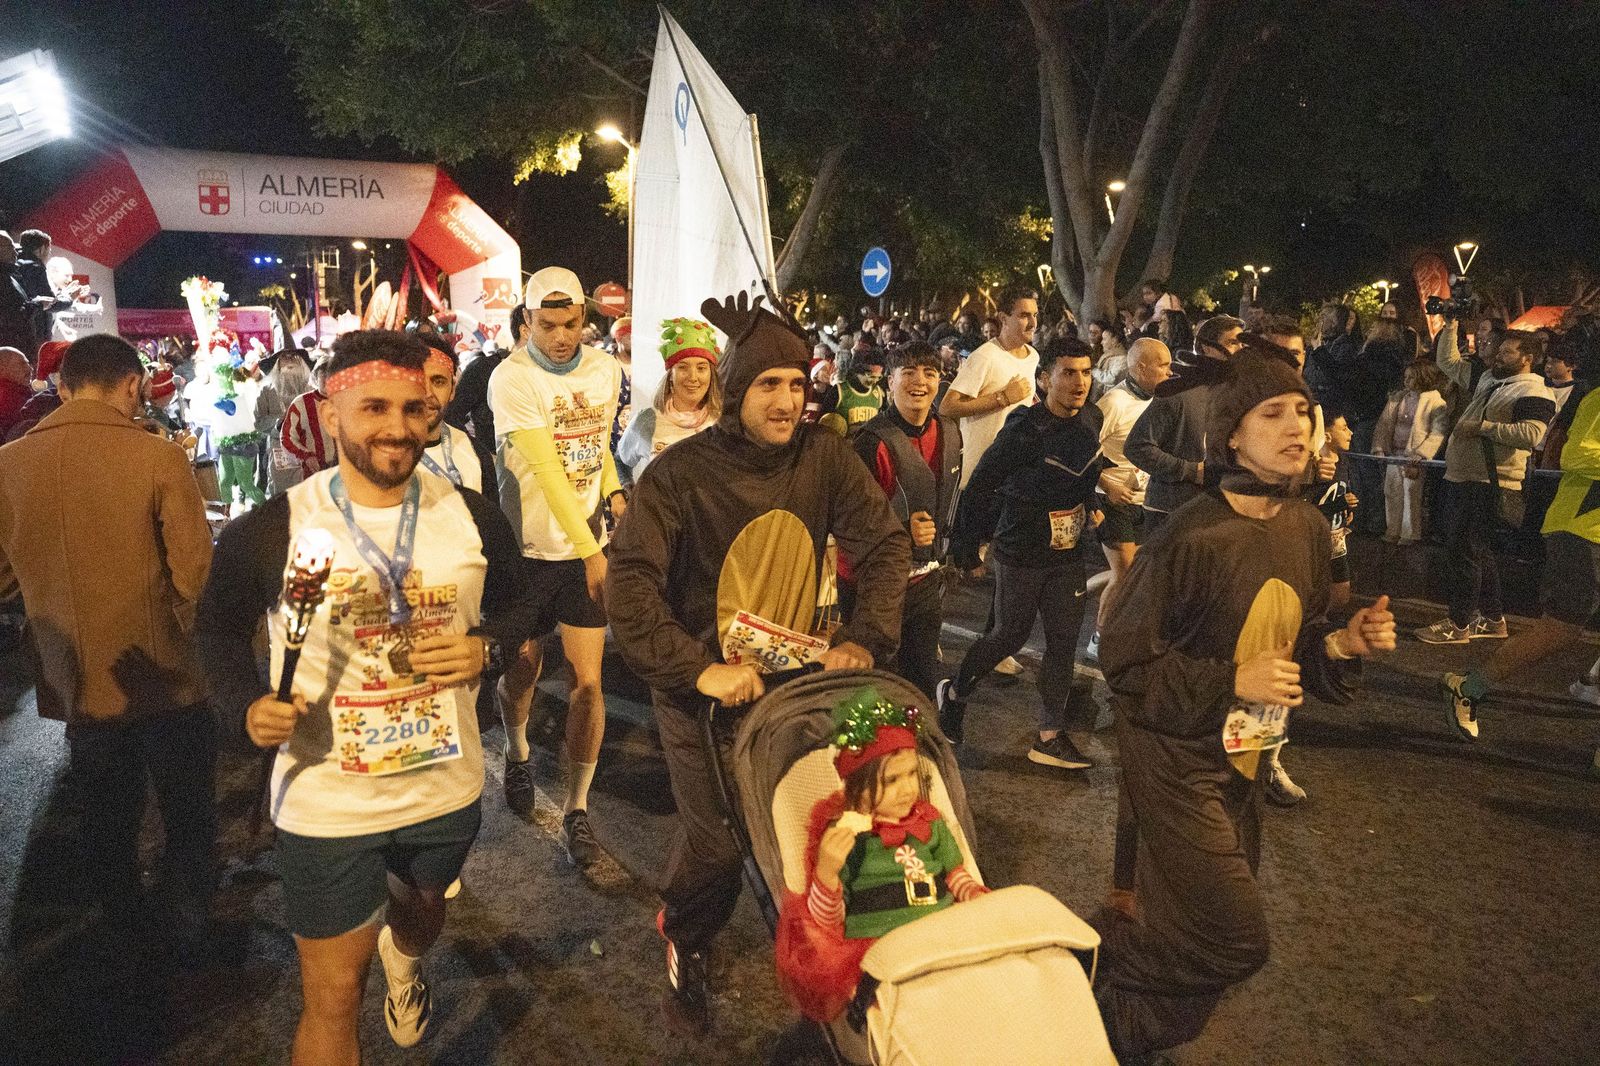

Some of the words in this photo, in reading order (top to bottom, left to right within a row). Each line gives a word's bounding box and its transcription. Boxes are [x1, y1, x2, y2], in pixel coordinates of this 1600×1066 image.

[259, 174, 385, 200] ALMERÍA
[259, 200, 324, 216] CIUDAD
[82, 233, 98, 248] es
[95, 198, 138, 236] deporte
[446, 221, 483, 256] deporte
[569, 446, 597, 462] 1623
[365, 718, 430, 745] 2280
